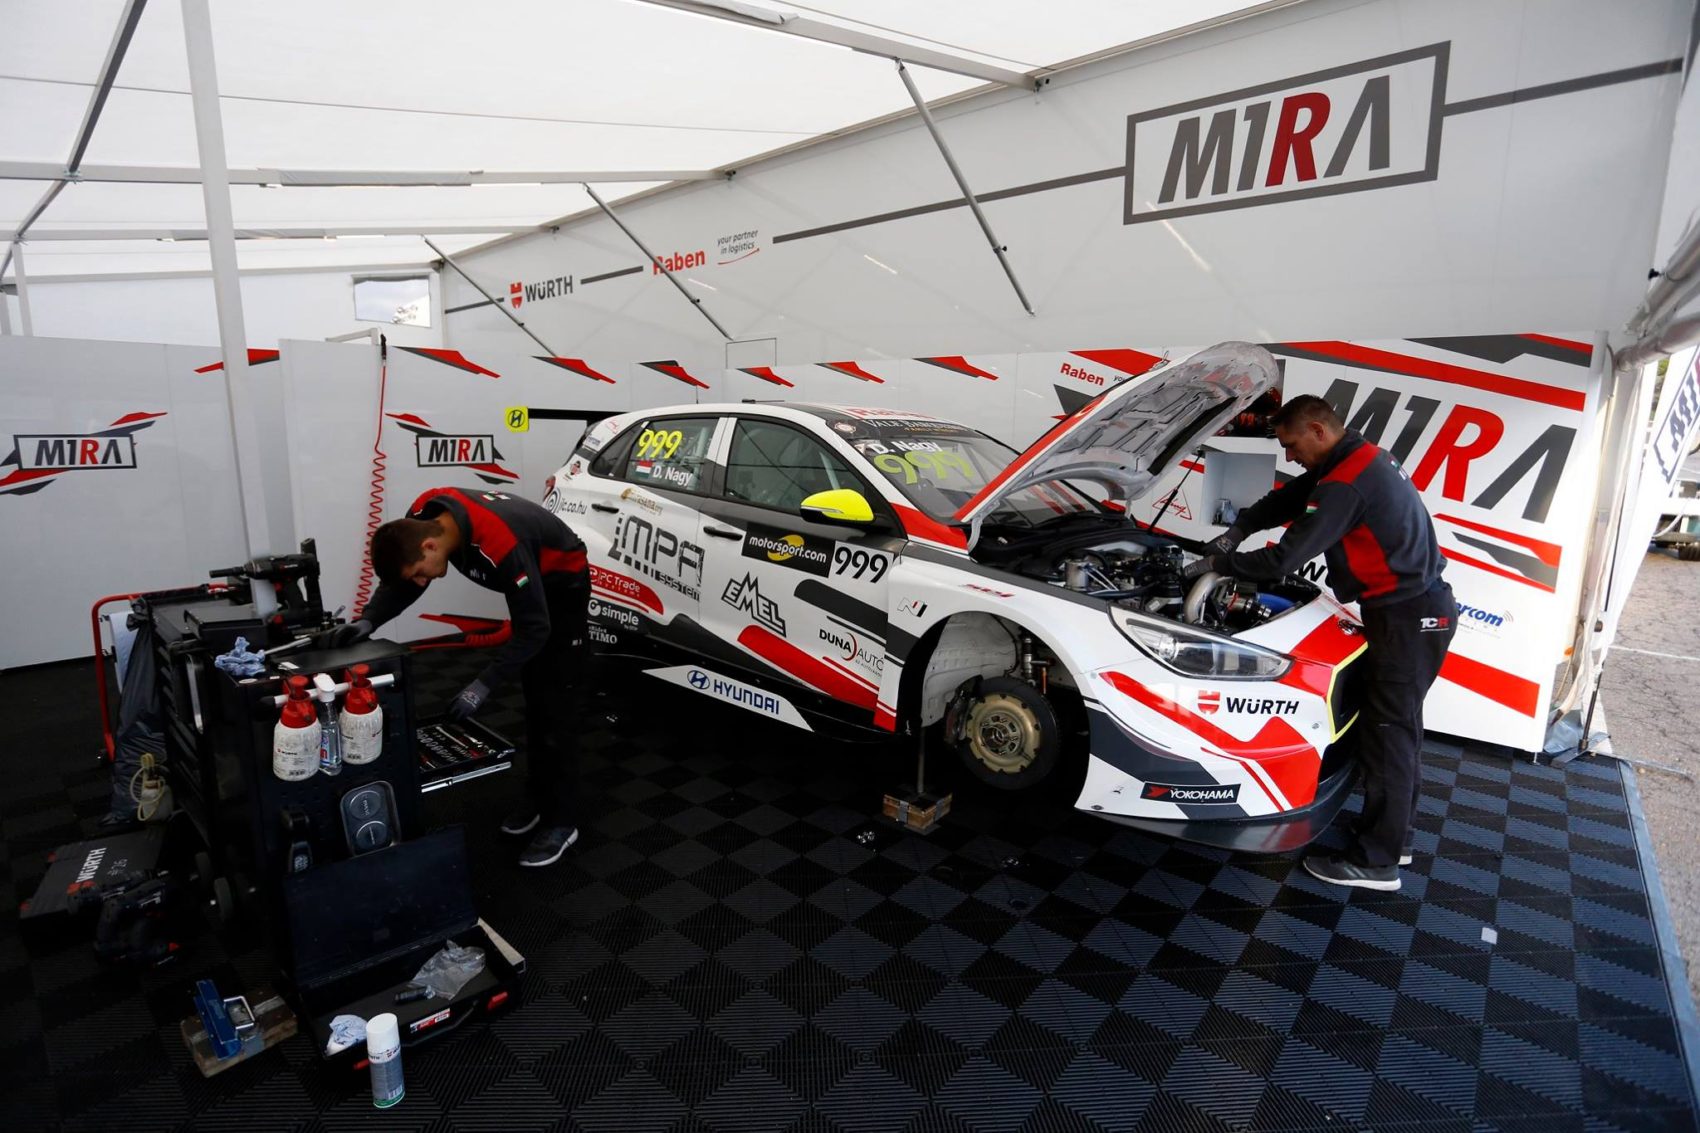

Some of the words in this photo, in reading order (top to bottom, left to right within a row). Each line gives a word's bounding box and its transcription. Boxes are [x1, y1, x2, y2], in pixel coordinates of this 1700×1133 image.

[1158, 75, 1390, 205] M1RA
[728, 241, 755, 254] logistics
[733, 230, 759, 242] partner
[653, 250, 706, 276] Raben
[1060, 362, 1105, 386] Raben
[34, 439, 122, 466] M1RA
[428, 439, 487, 464] M1RA
[637, 429, 683, 458] 999
[894, 440, 943, 454] Nagy
[653, 465, 663, 479] D.
[666, 467, 692, 487] Nagy
[873, 450, 975, 485] 999
[749, 535, 827, 564] motorsport.com
[834, 546, 889, 584] 999
[614, 576, 640, 593] Trade
[601, 605, 640, 626] simple
[721, 572, 787, 638] EMEL
[589, 630, 618, 645] TIMO
[820, 629, 852, 654] DUNA
[714, 679, 780, 715] HYUNDAI
[1170, 788, 1235, 800] YOKOHAMA
